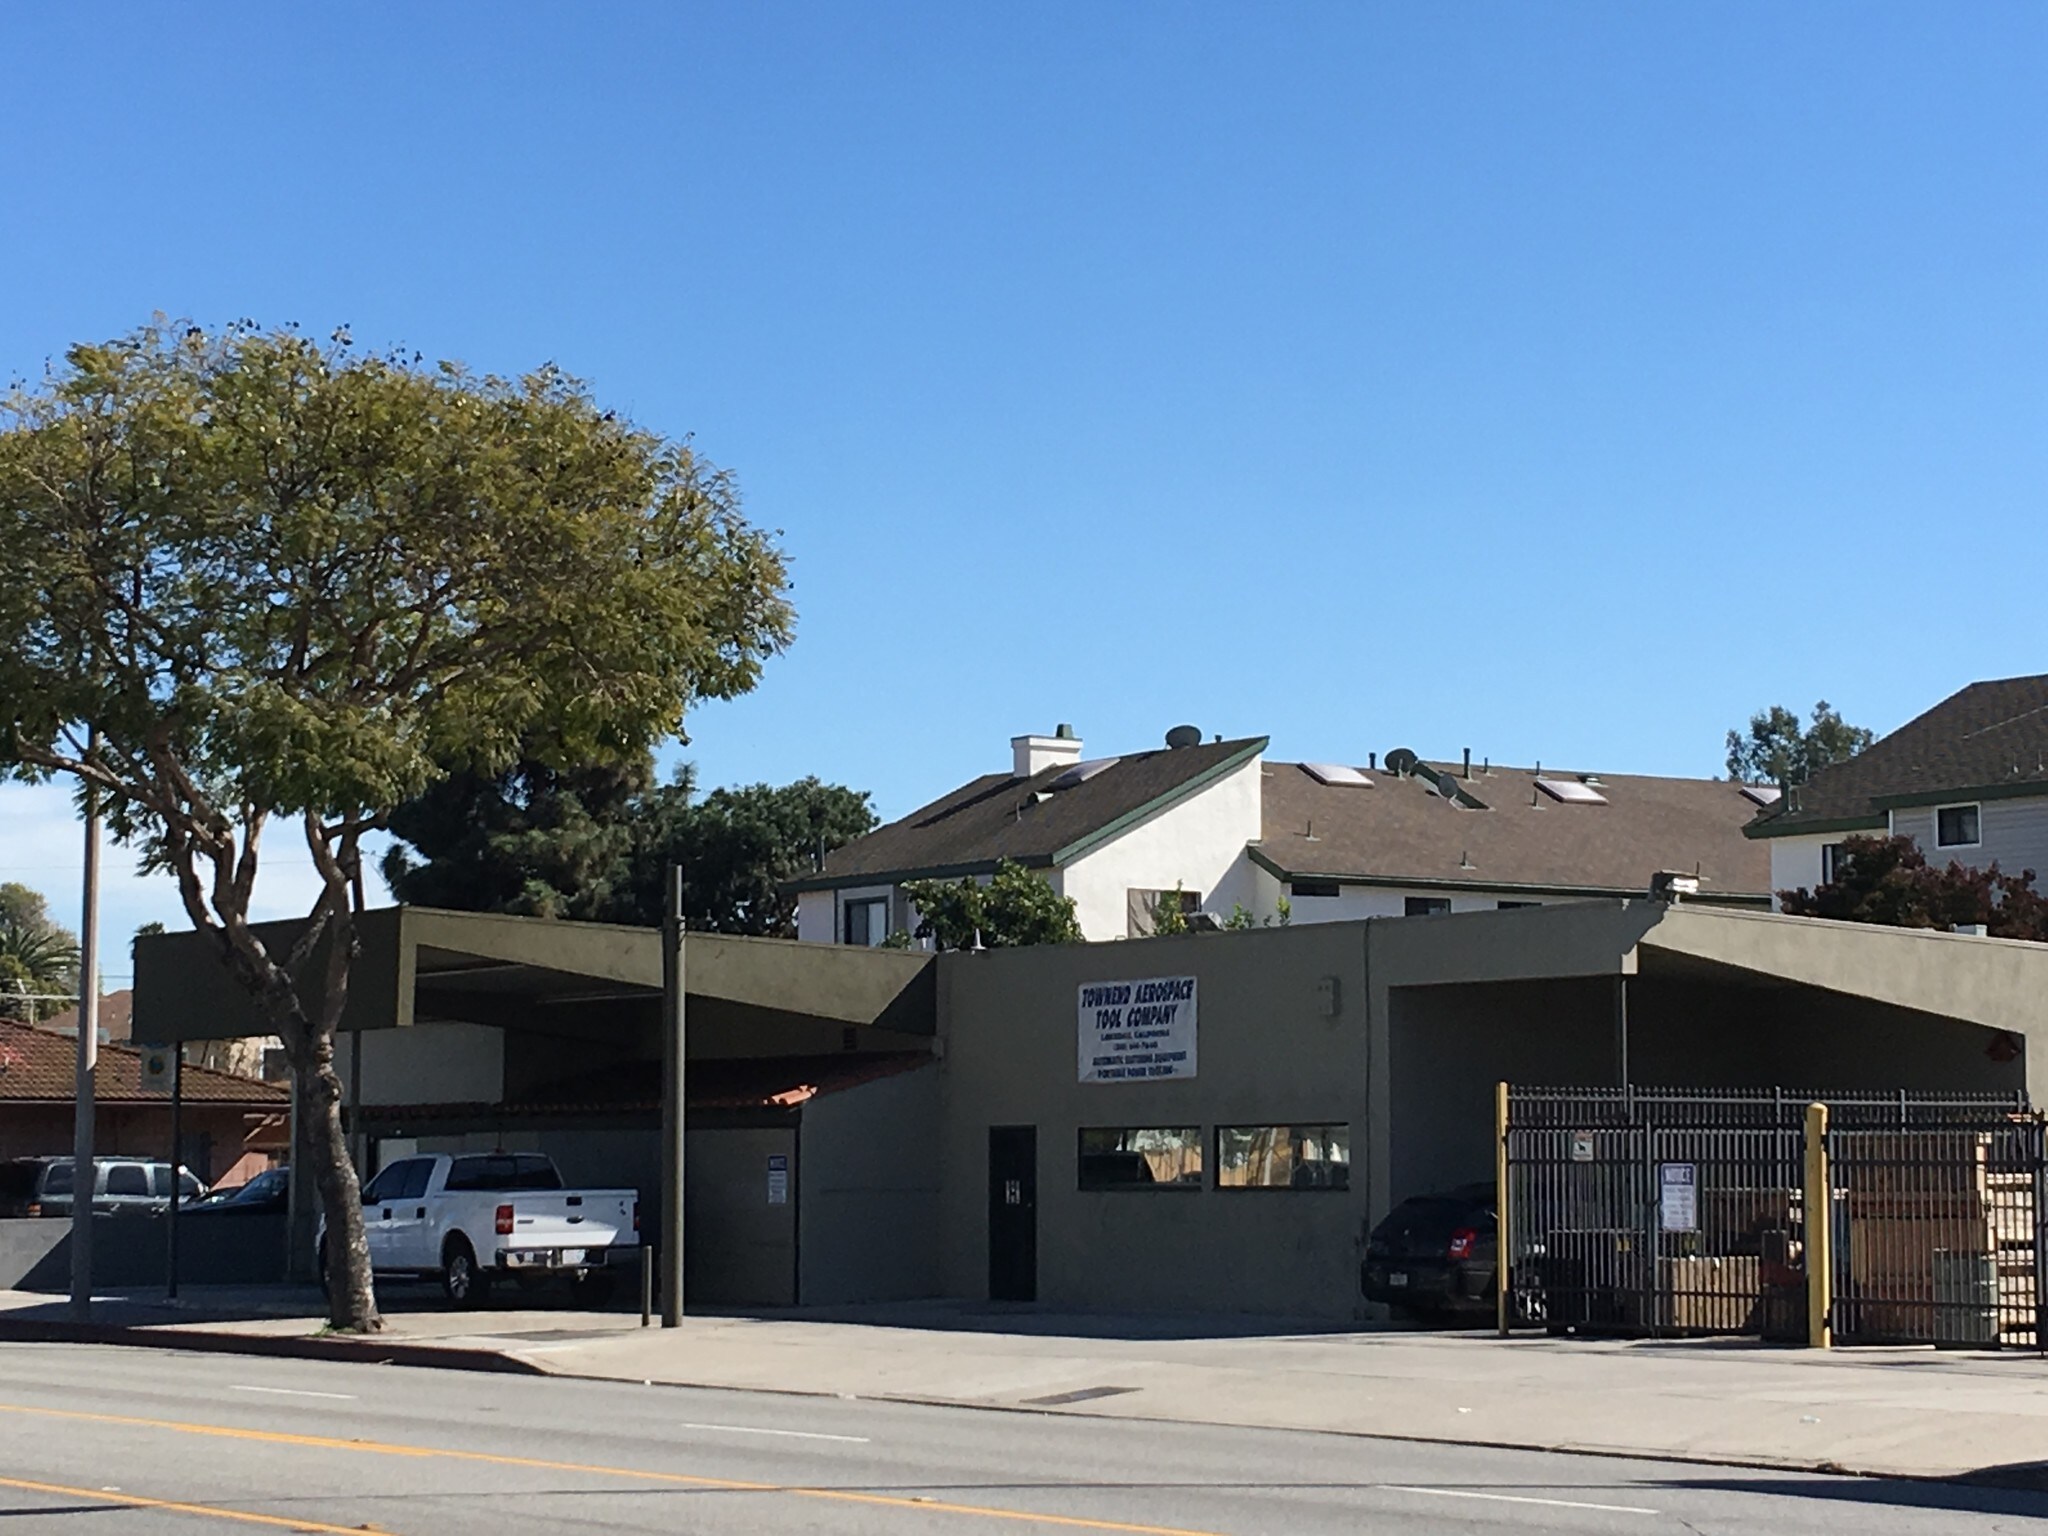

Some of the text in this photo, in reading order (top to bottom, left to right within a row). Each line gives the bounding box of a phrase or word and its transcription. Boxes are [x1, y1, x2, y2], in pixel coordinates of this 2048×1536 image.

[1134, 979, 1194, 1004] AEROSPACE
[1096, 1004, 1178, 1029] TOOL COMPANY
